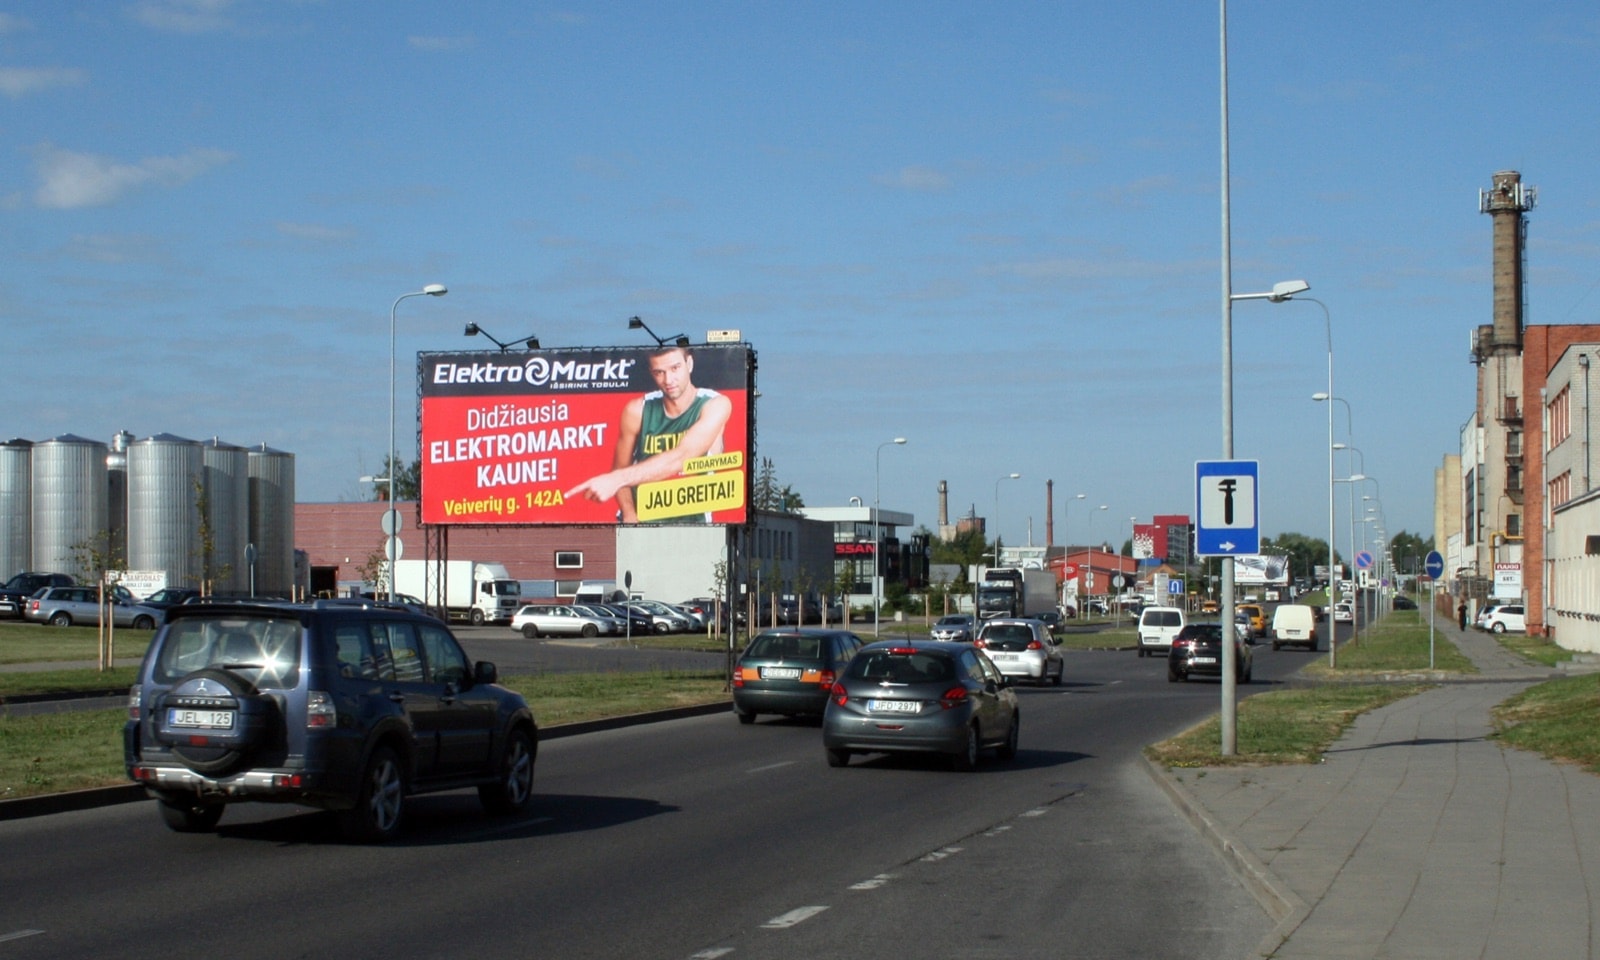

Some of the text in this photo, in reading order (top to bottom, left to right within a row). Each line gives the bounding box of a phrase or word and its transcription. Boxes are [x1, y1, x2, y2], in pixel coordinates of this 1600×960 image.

[433, 358, 630, 385] Elektro Markt
[592, 380, 629, 389] TOBULAI
[466, 399, 569, 431] Didžiausia
[430, 423, 607, 464] ELEKTROMARKT
[644, 430, 686, 454] LIETU
[476, 458, 557, 488] KAUNE!
[686, 455, 738, 472] ATIDARYMAS
[443, 489, 564, 517] Veiverių g. 142A
[645, 480, 735, 510] JAU GREITAI!
[835, 544, 876, 554] SSAN
[177, 711, 230, 724] JEL 125
[898, 702, 914, 710] 297
